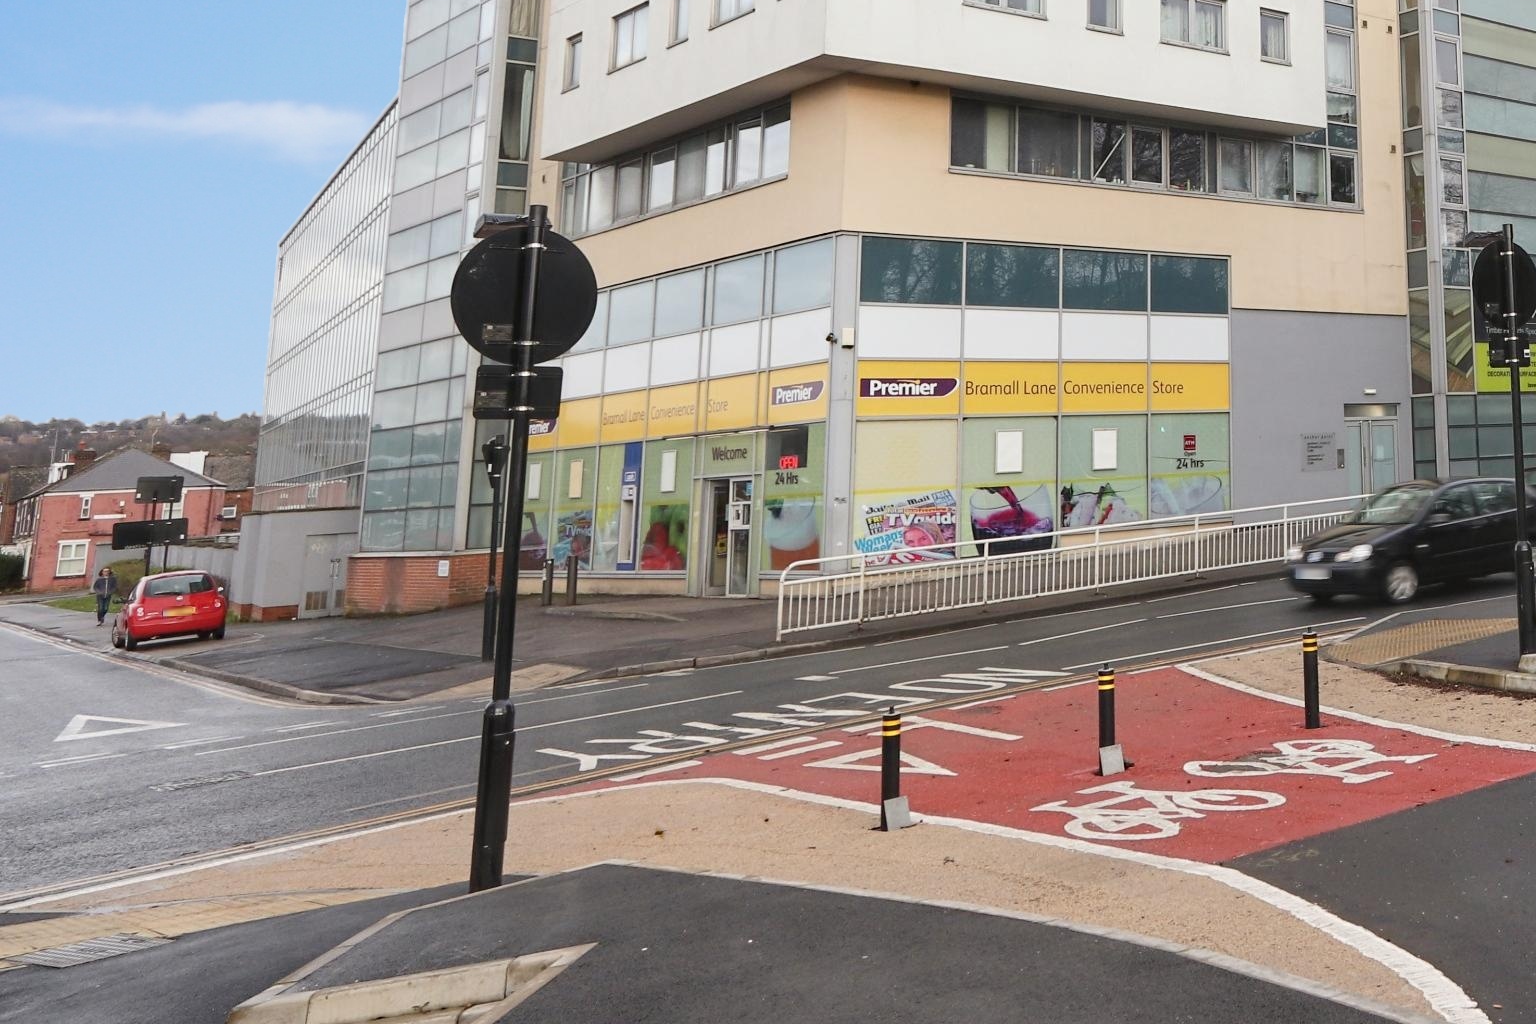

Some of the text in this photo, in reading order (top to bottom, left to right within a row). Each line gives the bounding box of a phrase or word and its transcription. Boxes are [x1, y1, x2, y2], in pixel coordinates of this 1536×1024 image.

[775, 386, 813, 404] Premier
[869, 379, 1184, 396] Premier Bramall Lane Convenience Store
[528, 397, 729, 435] remier Bramall Lane Convenience Store
[1184, 439, 1196, 447] ATM
[711, 446, 748, 462] Welcome
[779, 455, 799, 470] OPEN
[1176, 457, 1205, 470] 24 hrs
[775, 471, 798, 485] 24 Hrs
[907, 495, 930, 506] Mail
[534, 666, 1074, 773] NO ENTRY
